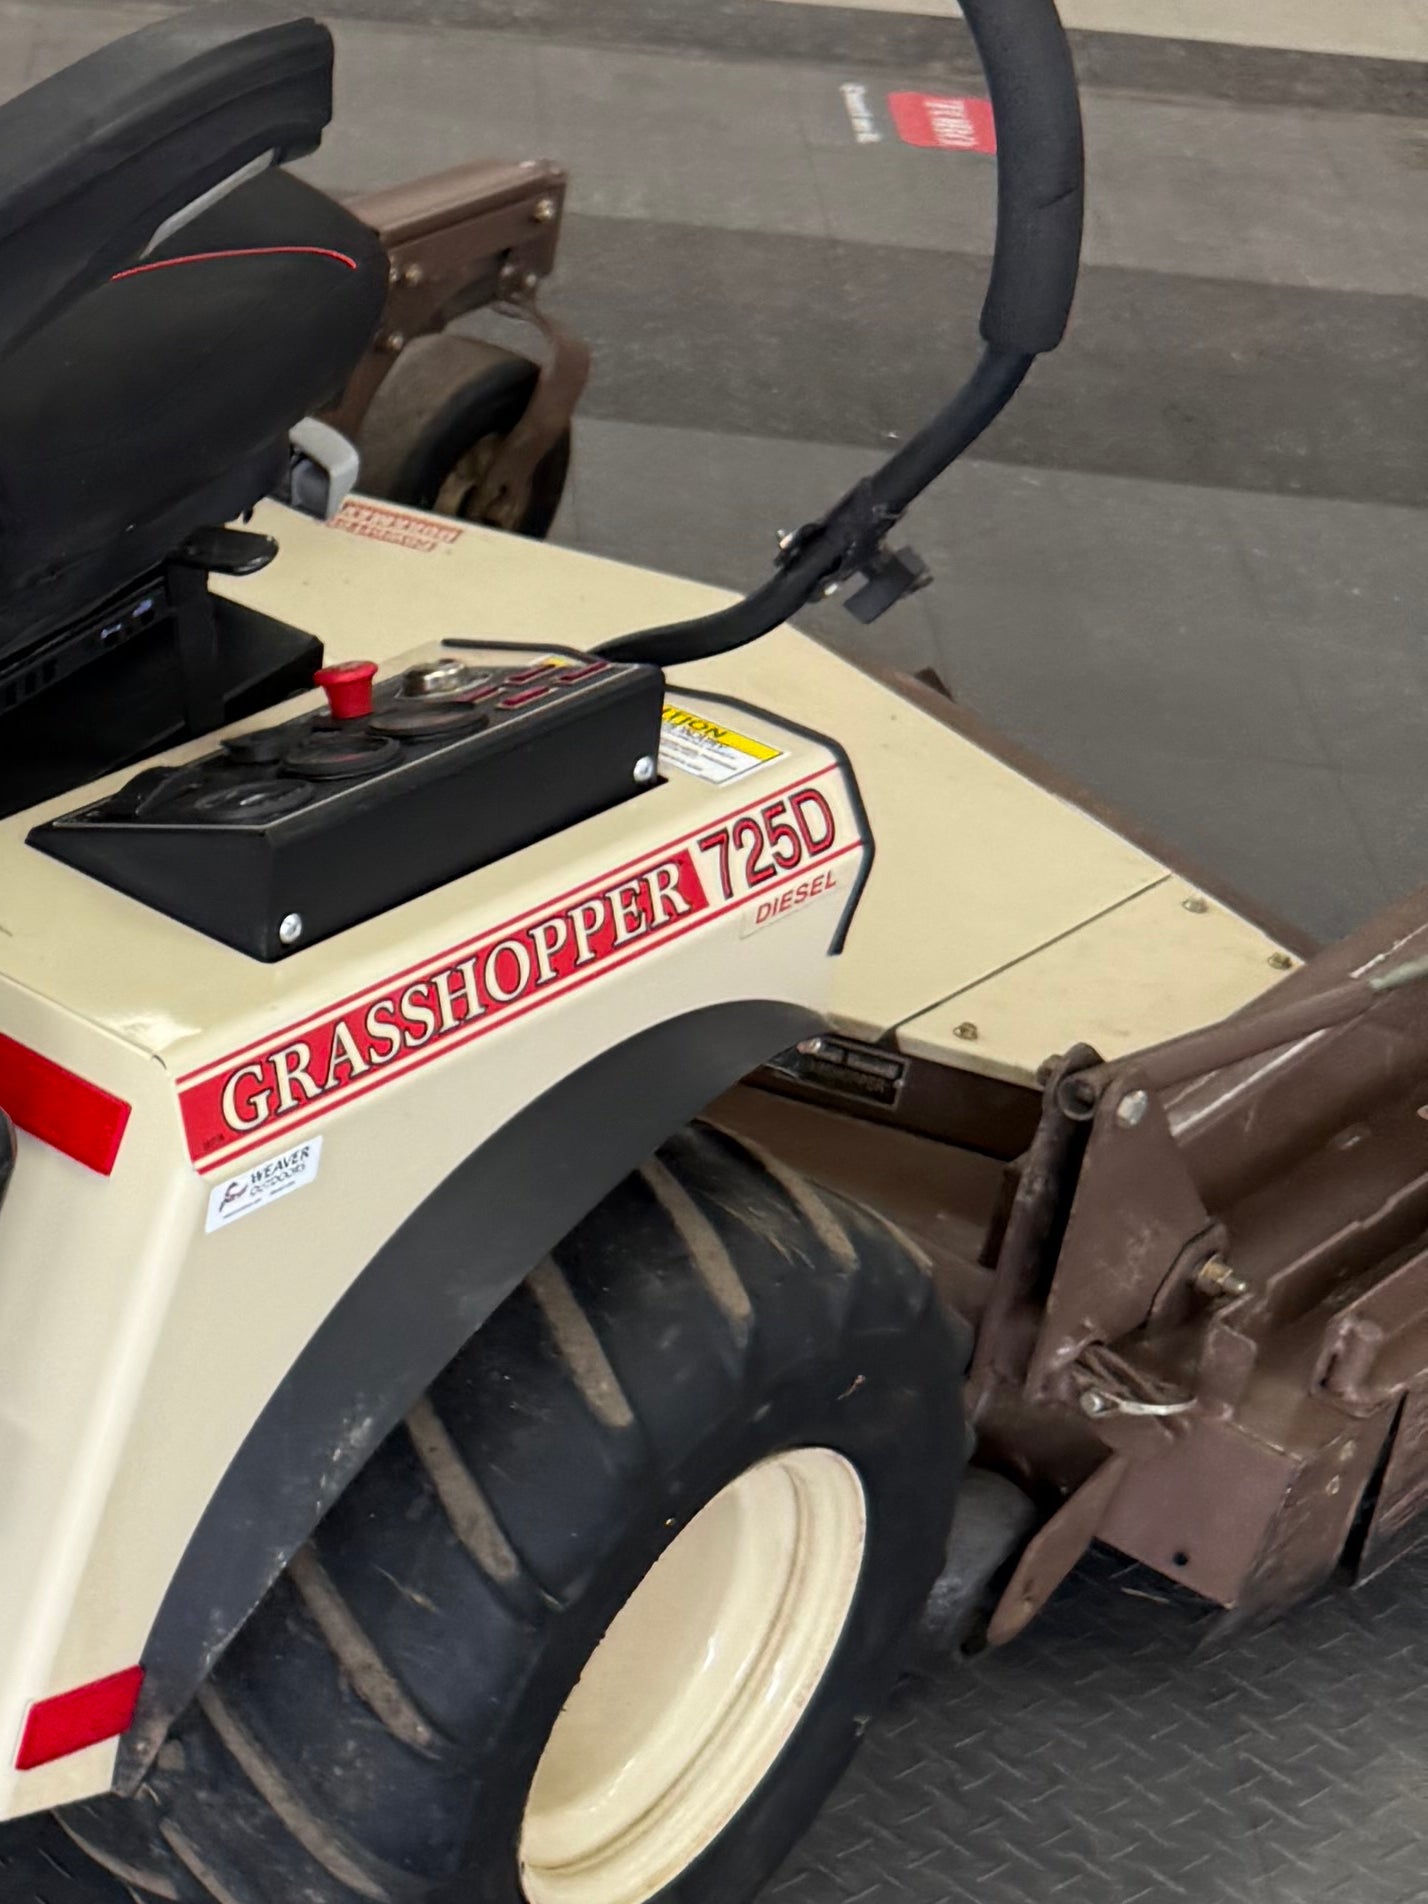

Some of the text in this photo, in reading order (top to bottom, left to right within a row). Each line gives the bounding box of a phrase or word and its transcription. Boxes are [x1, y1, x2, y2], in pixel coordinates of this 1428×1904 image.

[700, 787, 837, 901] 725D
[754, 870, 838, 925] DIESEL
[221, 858, 689, 1135] GRASSHOPPER
[250, 1145, 310, 1183] WEAVER
